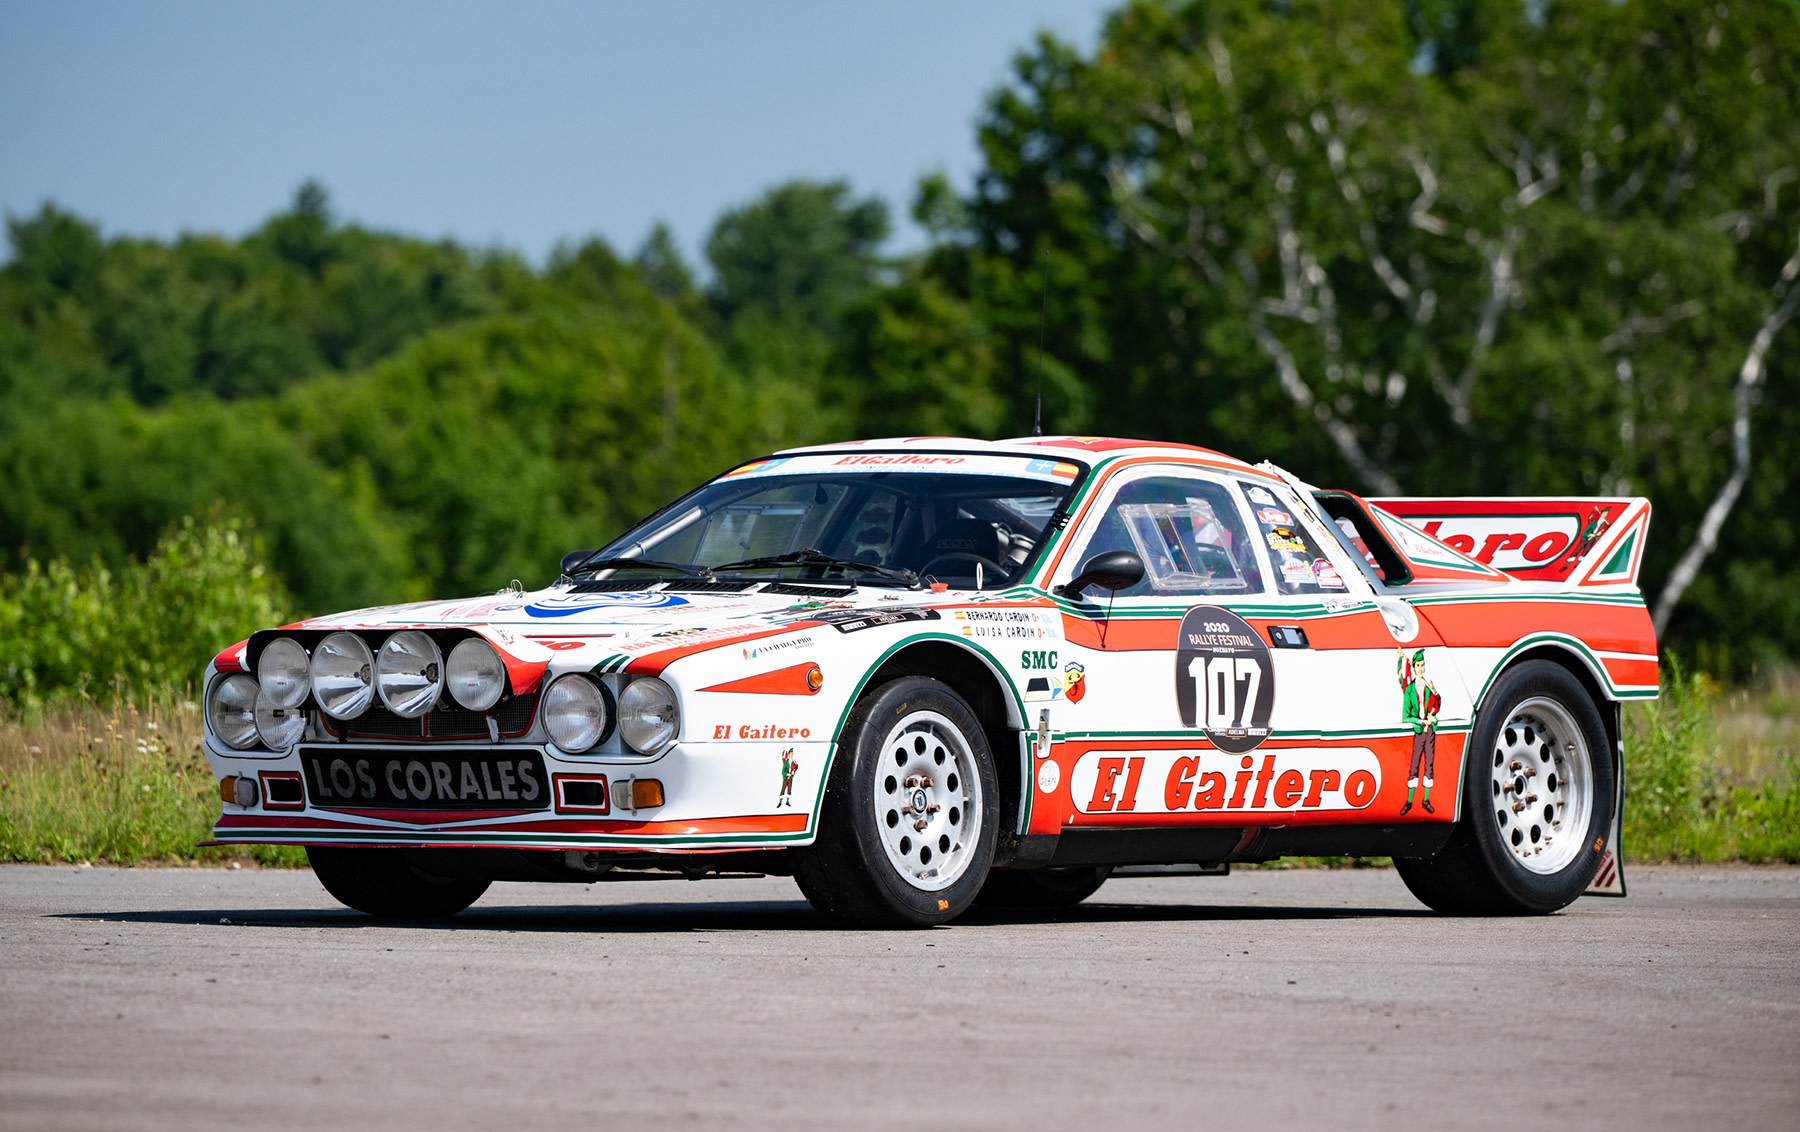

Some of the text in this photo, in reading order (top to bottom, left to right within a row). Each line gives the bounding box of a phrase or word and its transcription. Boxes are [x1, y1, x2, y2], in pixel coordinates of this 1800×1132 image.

[965, 611, 1004, 623] BERNARDO
[1004, 612, 1031, 623] CARDIN
[975, 626, 1003, 638] LUISA
[1006, 627, 1035, 638] CARDIN
[1203, 622, 1230, 633] 2020
[1188, 634, 1255, 647] RALLYE FESTIVAL
[1021, 650, 1058, 670] SMC
[1188, 656, 1262, 728] 107
[712, 724, 811, 740] El Gaitero
[311, 758, 540, 801] LOS CORALES
[1086, 754, 1377, 812] El Gaitero
